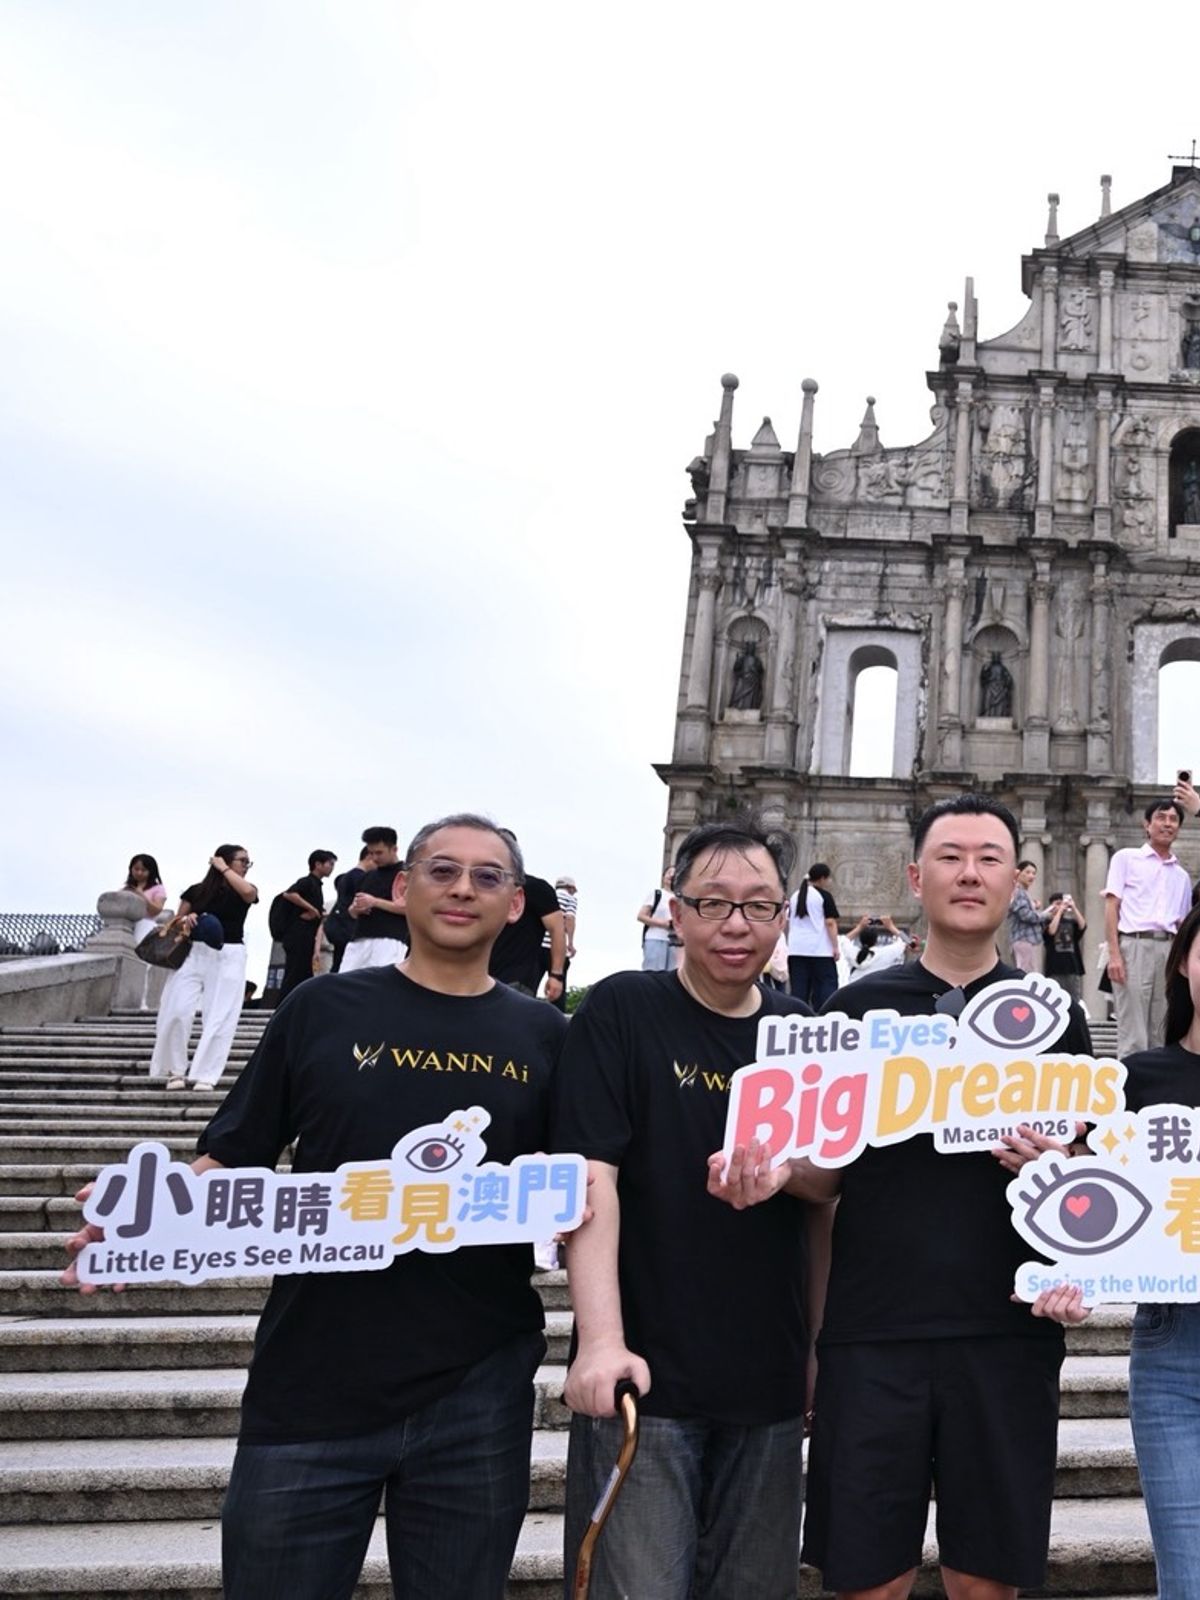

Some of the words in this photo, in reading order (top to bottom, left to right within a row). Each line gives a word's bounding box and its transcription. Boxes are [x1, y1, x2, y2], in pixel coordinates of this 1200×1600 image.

[766, 1021, 859, 1057] Little
[870, 1018, 957, 1055] Eyes,
[390, 1048, 494, 1073] WANN
[502, 1063, 528, 1084] Ai
[735, 1063, 869, 1159] Big
[876, 1056, 1120, 1138] Dreams
[943, 1126, 1013, 1145] Macau
[96, 1152, 577, 1245] 小眼睛看見澳門
[88, 1249, 164, 1275] Little
[173, 1247, 237, 1274] Eyes
[243, 1245, 292, 1267] See
[299, 1241, 385, 1264] Macau
[1101, 1275, 1133, 1292] the
[1138, 1275, 1197, 1293] World
